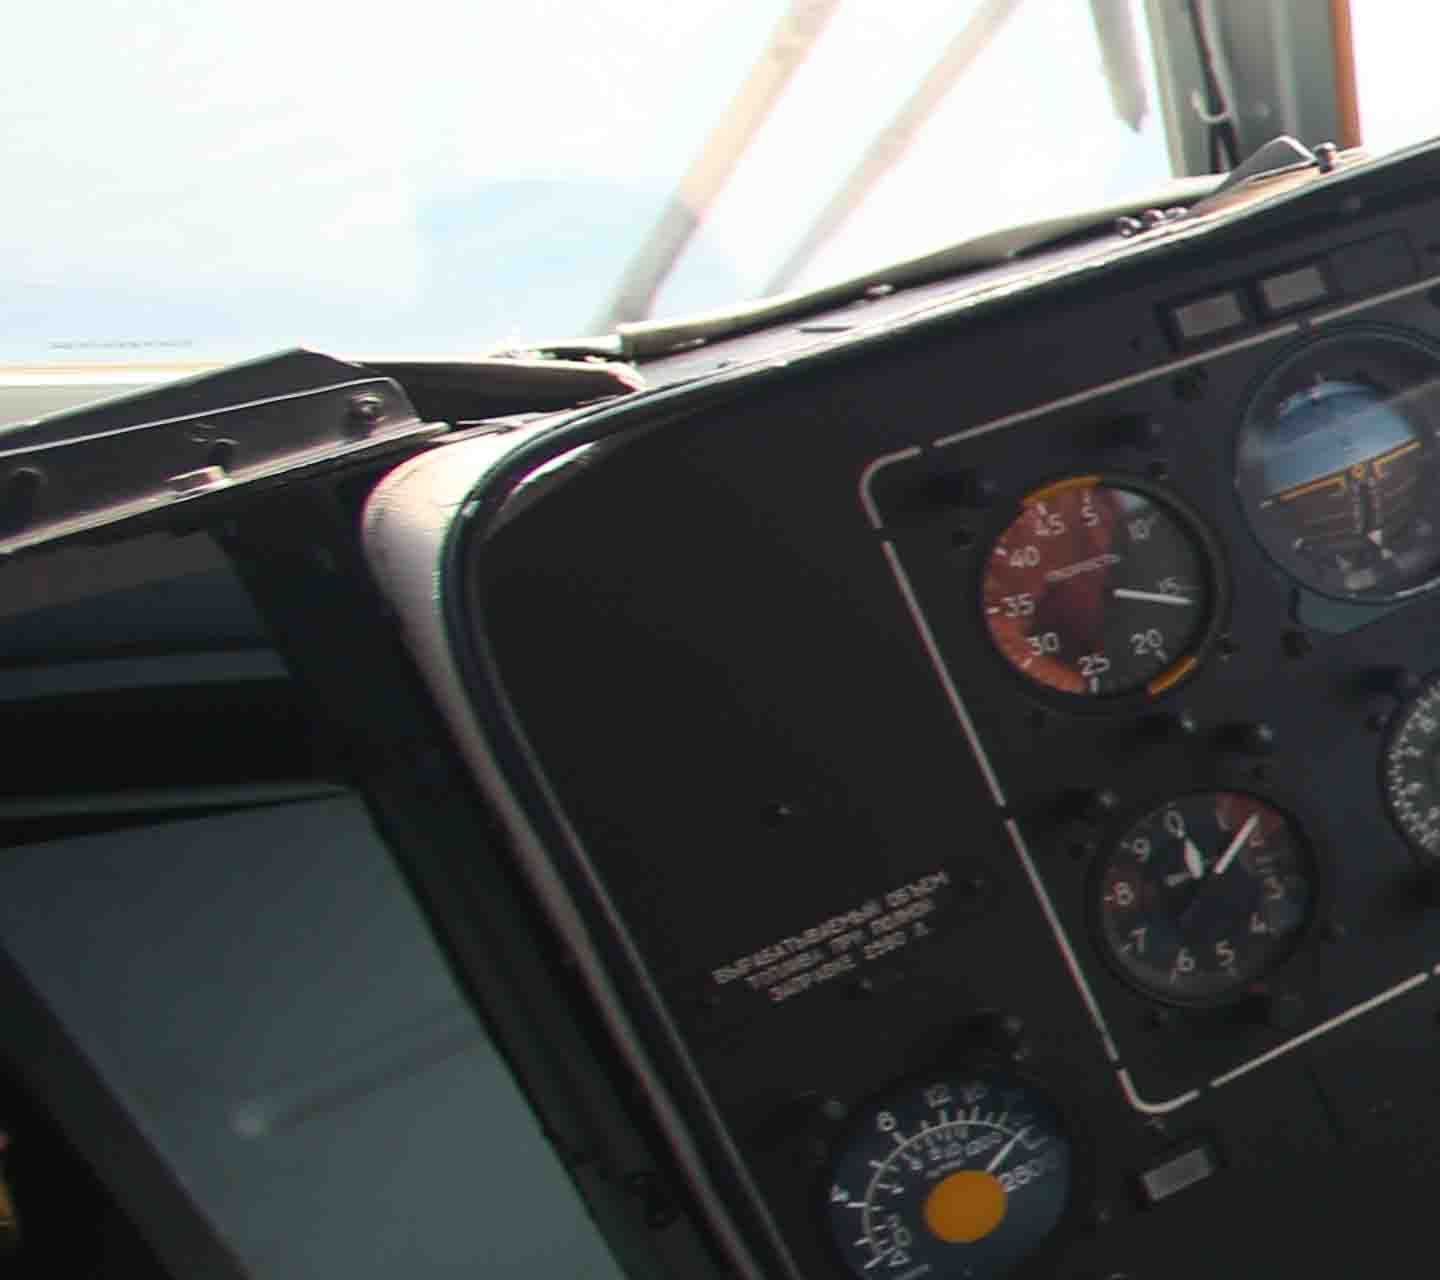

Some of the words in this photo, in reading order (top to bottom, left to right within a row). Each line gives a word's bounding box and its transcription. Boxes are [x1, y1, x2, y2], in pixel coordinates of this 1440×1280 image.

[1009, 545, 1041, 569] 40
[1002, 593, 1036, 618] 35
[1026, 631, 1060, 657] 30
[1129, 628, 1164, 656] 20
[1077, 652, 1111, 677] 25
[1165, 809, 1185, 837] 0
[1113, 880, 1135, 905] 8
[1176, 947, 1196, 972] 6
